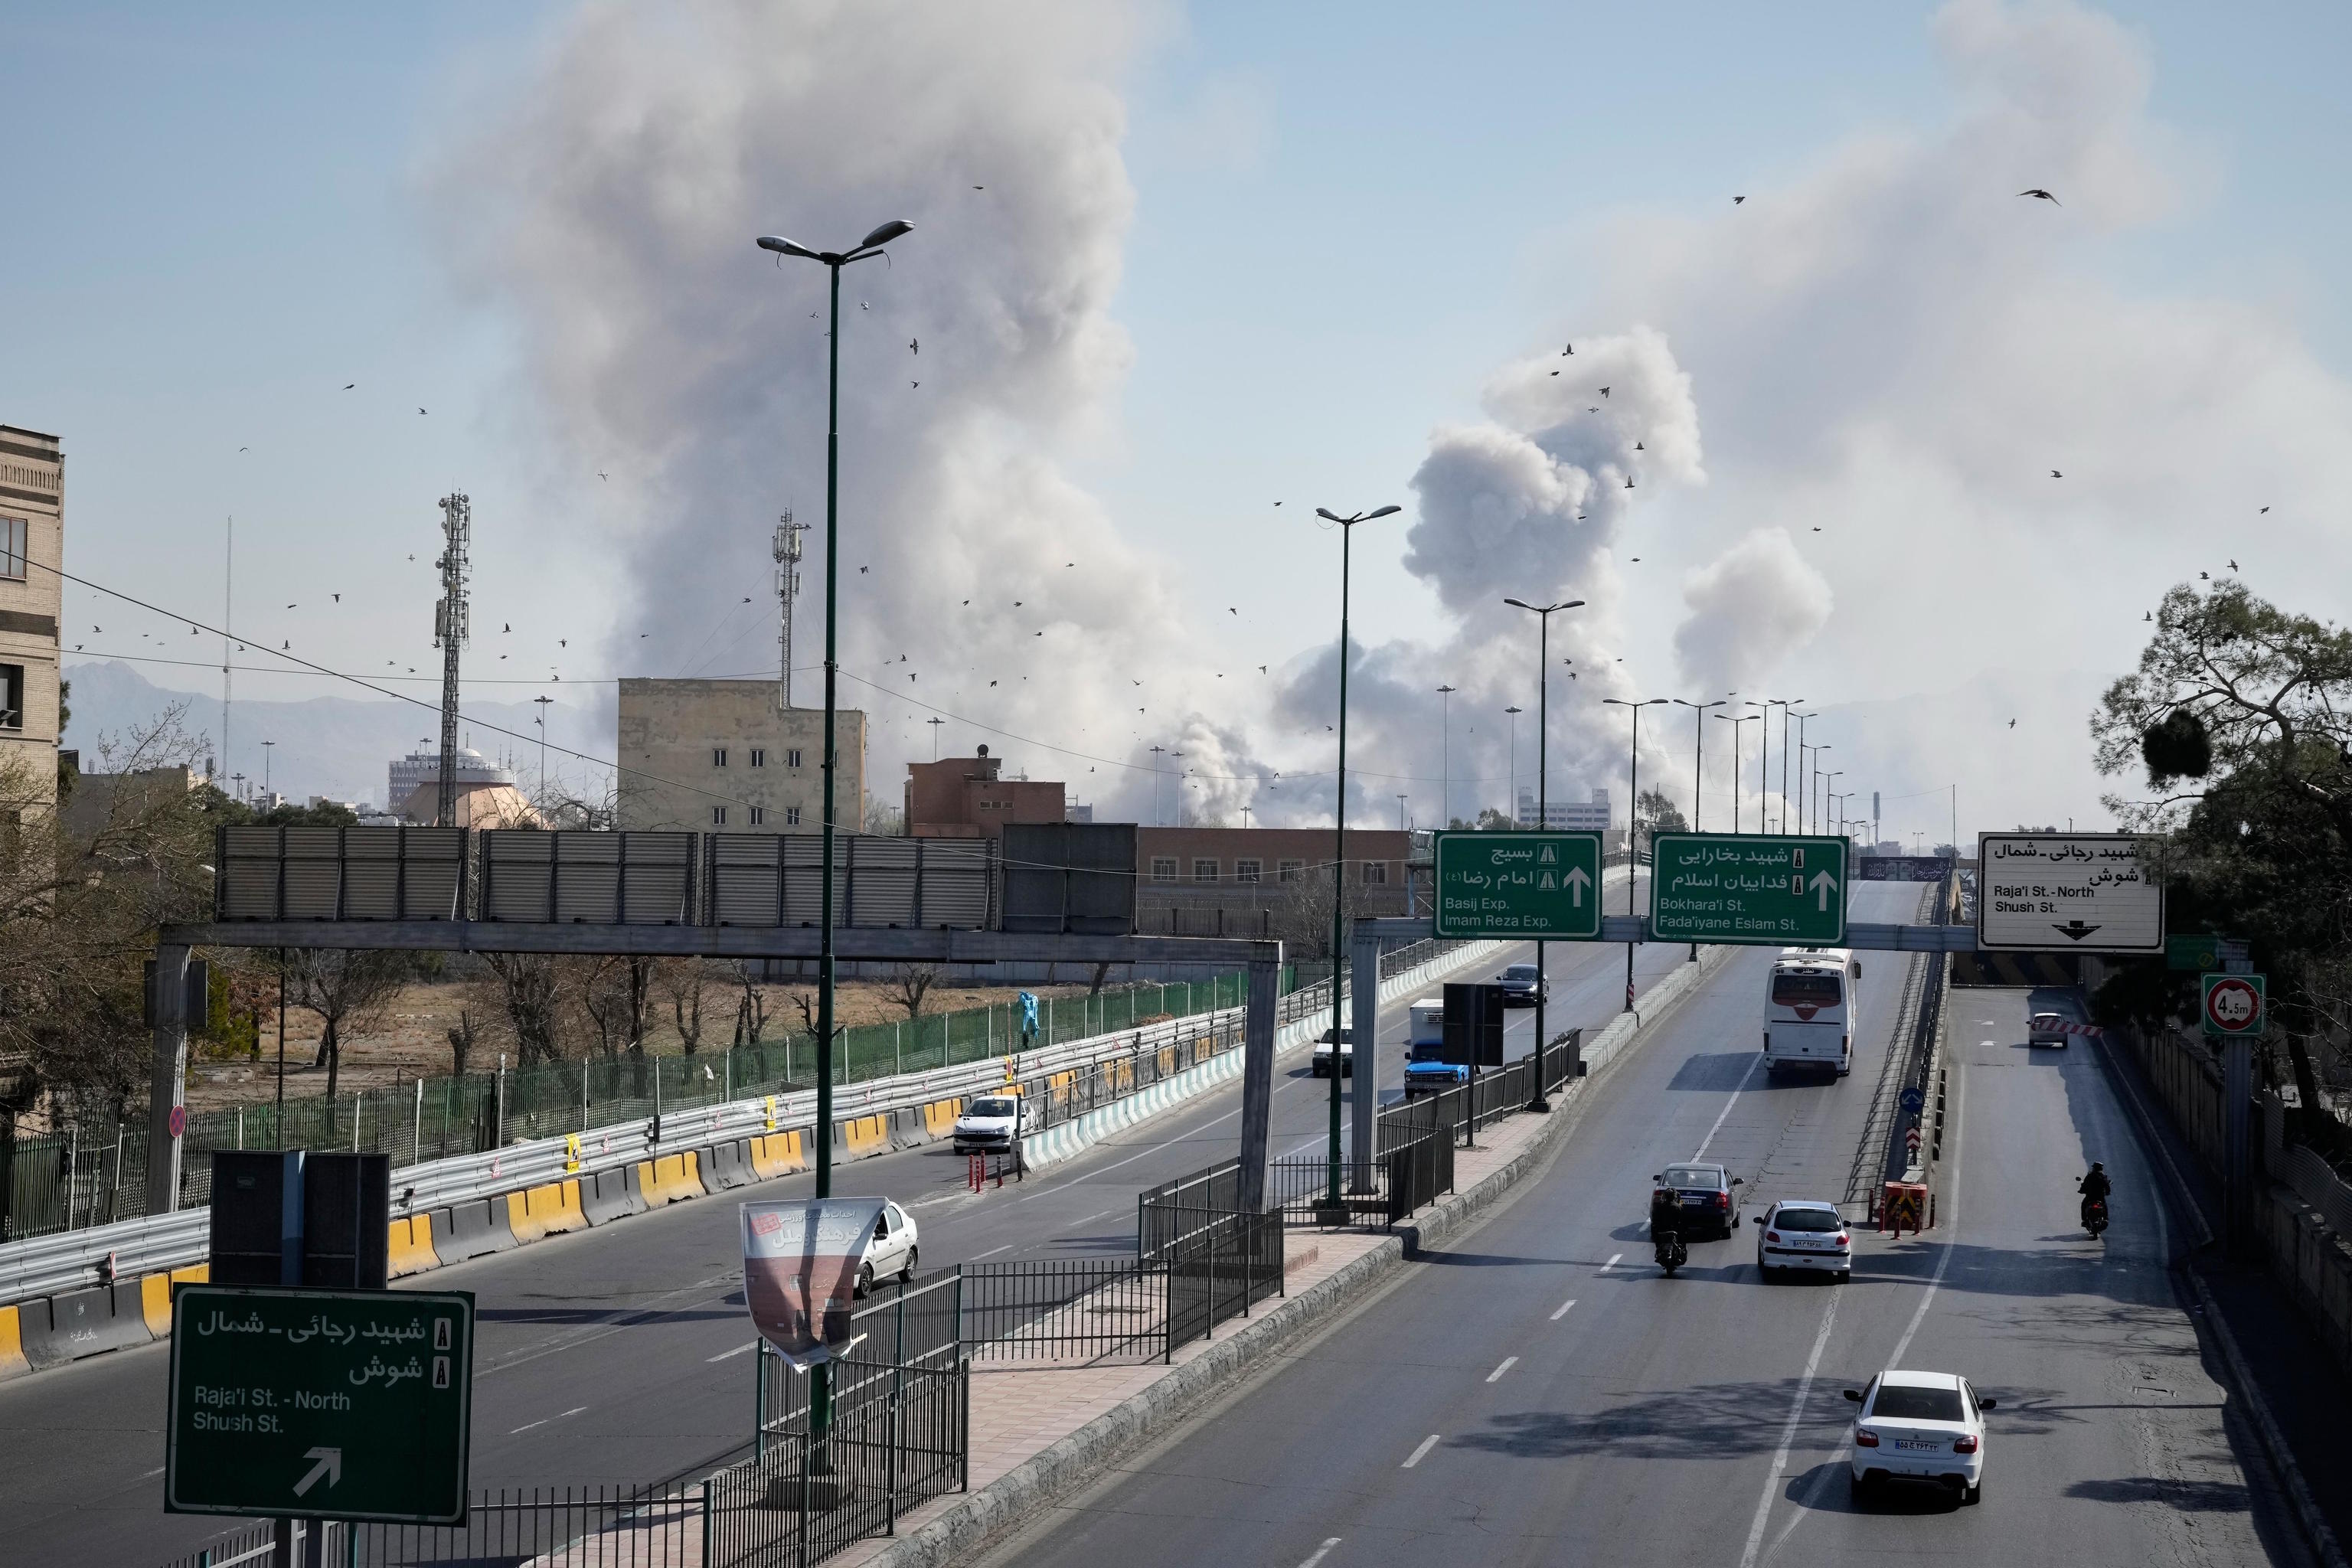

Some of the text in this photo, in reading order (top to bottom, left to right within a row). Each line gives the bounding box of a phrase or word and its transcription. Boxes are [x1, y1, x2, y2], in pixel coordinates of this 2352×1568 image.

[1491, 848, 1533, 864] بسیج
[1678, 847, 1788, 867] شهید بخارایی
[1994, 842, 2037, 859] شمال
[2099, 844, 2138, 861] شهید
[1497, 871, 1533, 890] امام
[1671, 874, 1718, 891] اسلام
[2089, 868, 2138, 887] شوش
[1994, 886, 2028, 898] Raja'i
[1446, 898, 1510, 911] Basij Exp.
[1660, 898, 1746, 911] Bokhara'i St.
[2040, 902, 2058, 913] St.
[1445, 915, 1552, 929] Imam Reza Exp.
[1660, 915, 1799, 930] Fada'iyane Eslam St.
[778, 1214, 804, 1223] ورزشی
[772, 1229, 803, 1249] ملل
[198, 1310, 264, 1336] شمال
[361, 1318, 426, 1344] شهید
[349, 1355, 423, 1388] شوش
[194, 1386, 246, 1408] Raja'i
[251, 1388, 278, 1407] St.
[295, 1390, 351, 1410] North
[193, 1411, 284, 1433] Shush St.
